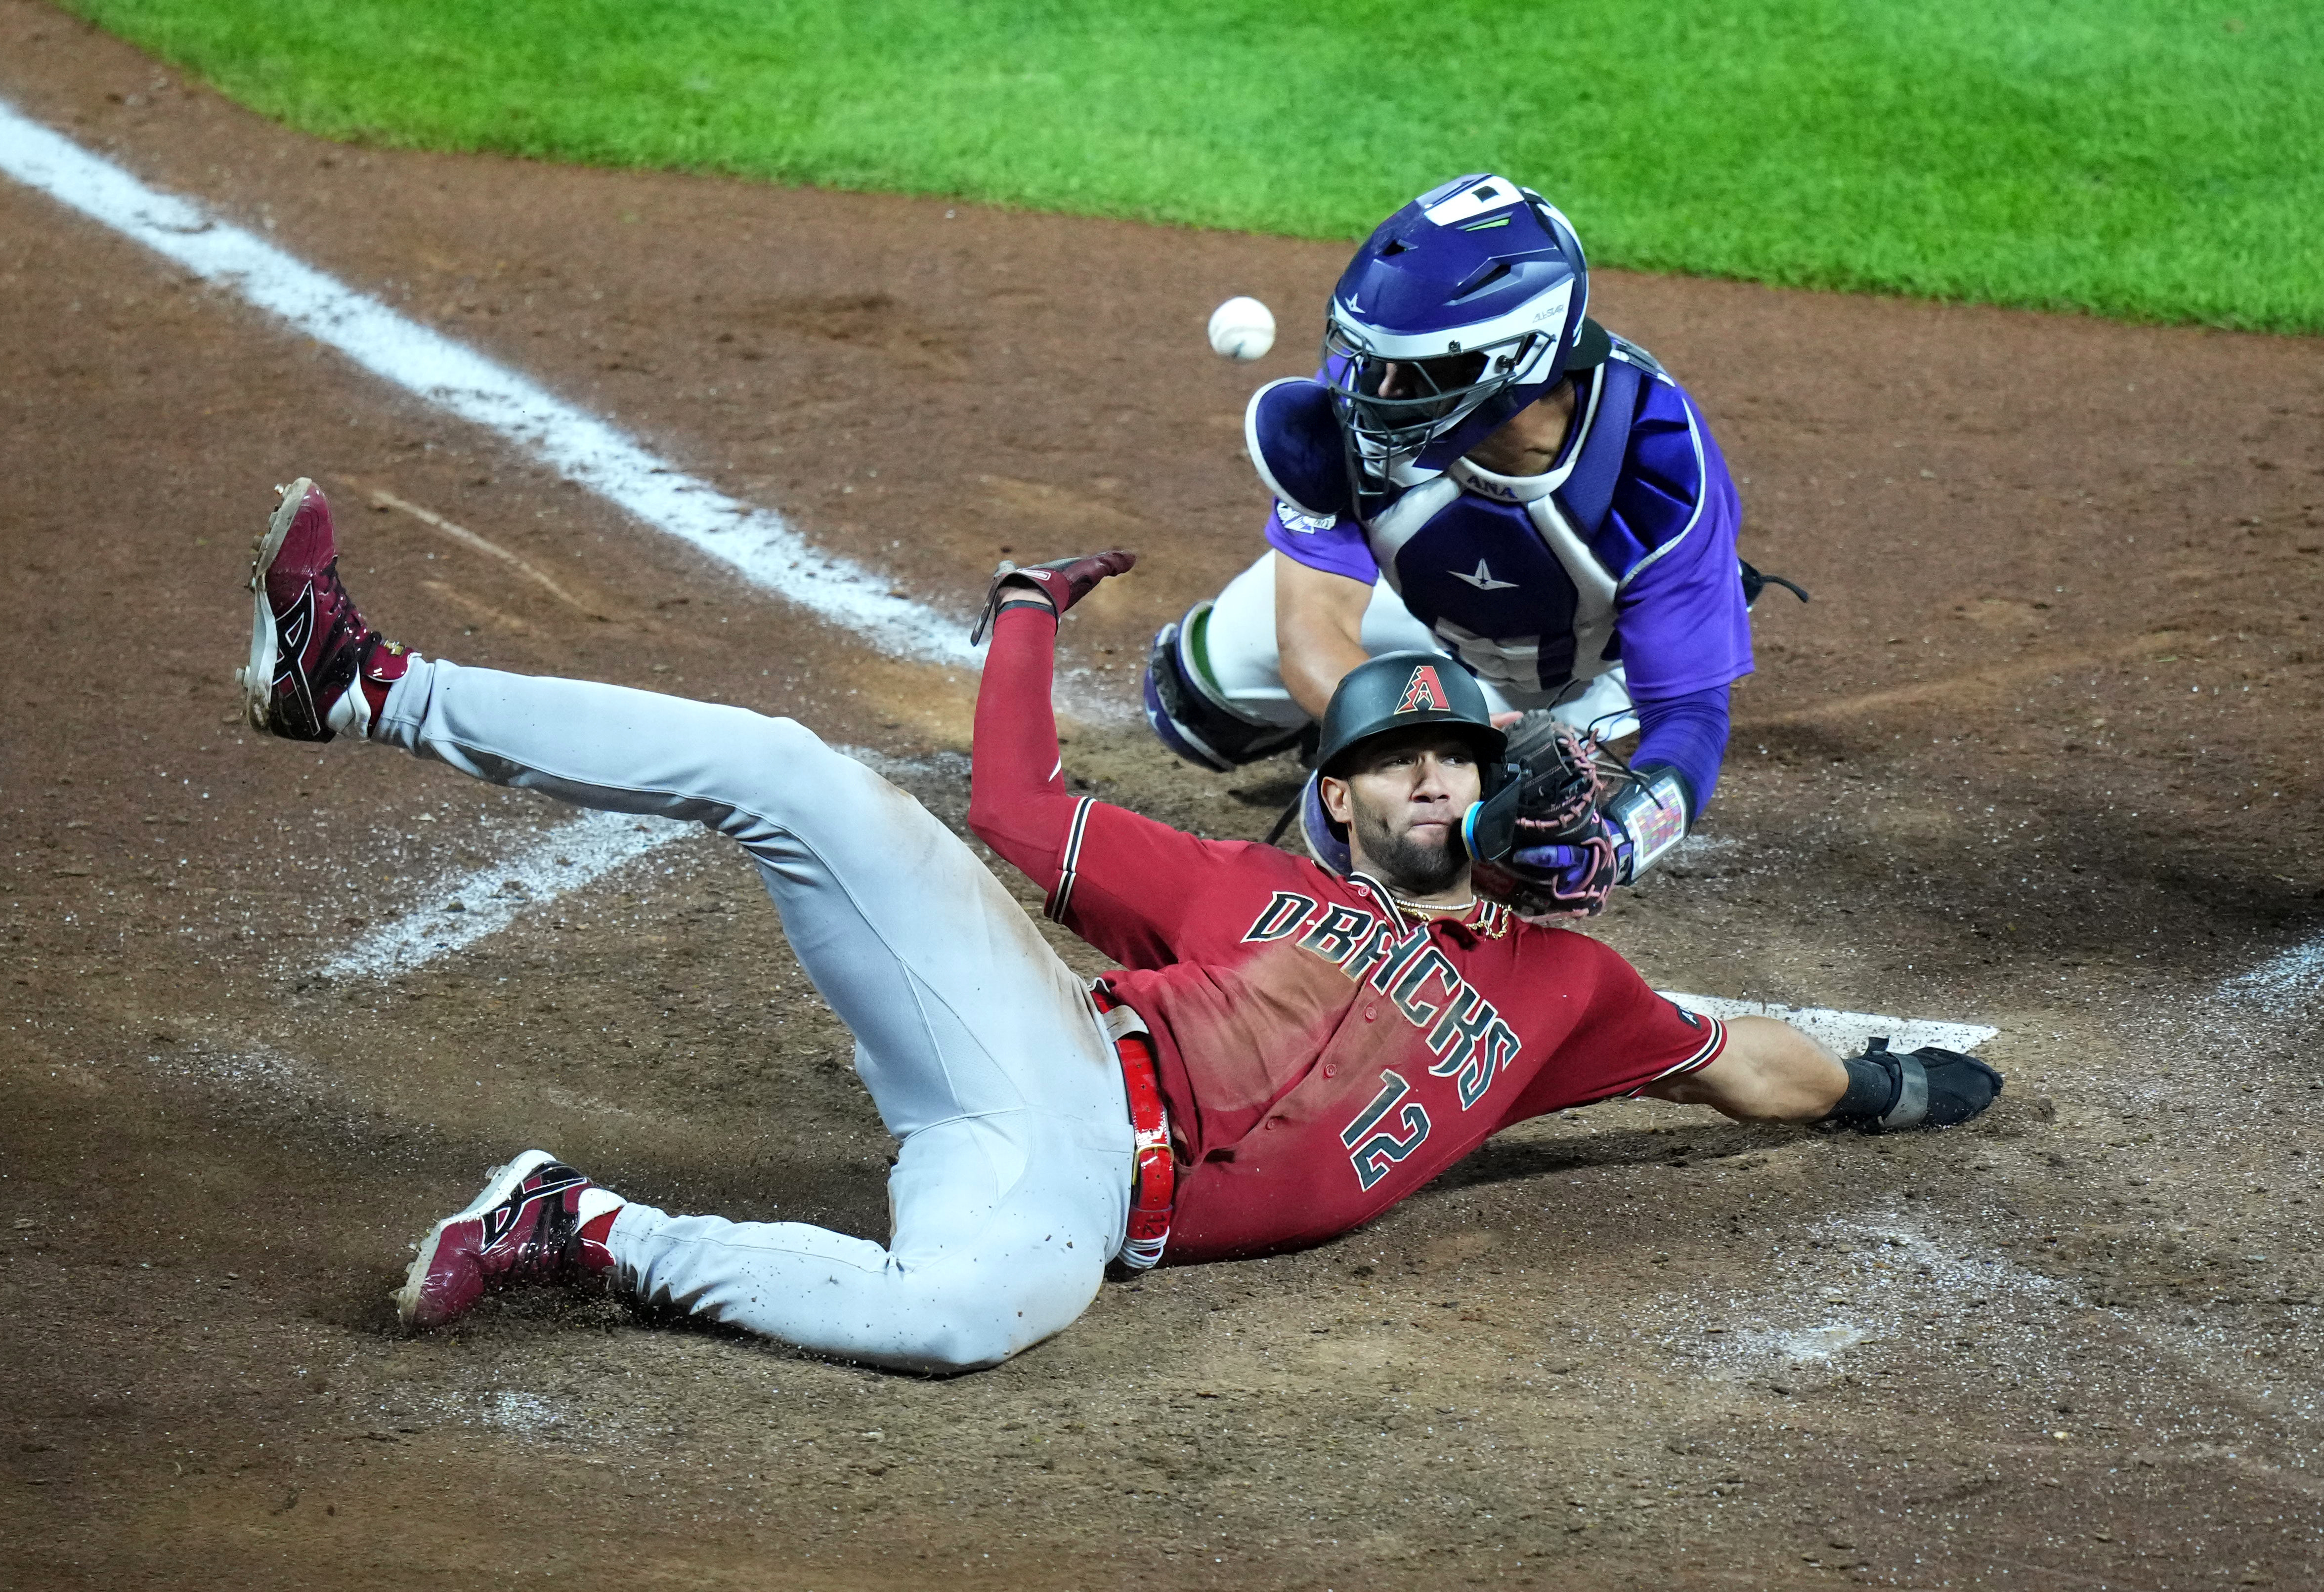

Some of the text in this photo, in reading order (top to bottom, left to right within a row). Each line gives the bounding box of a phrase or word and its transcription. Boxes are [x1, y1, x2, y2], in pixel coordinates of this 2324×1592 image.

[1394, 666, 1450, 714] A
[1340, 1068, 1431, 1192] 12
[1143, 1215, 1166, 1236] 12
